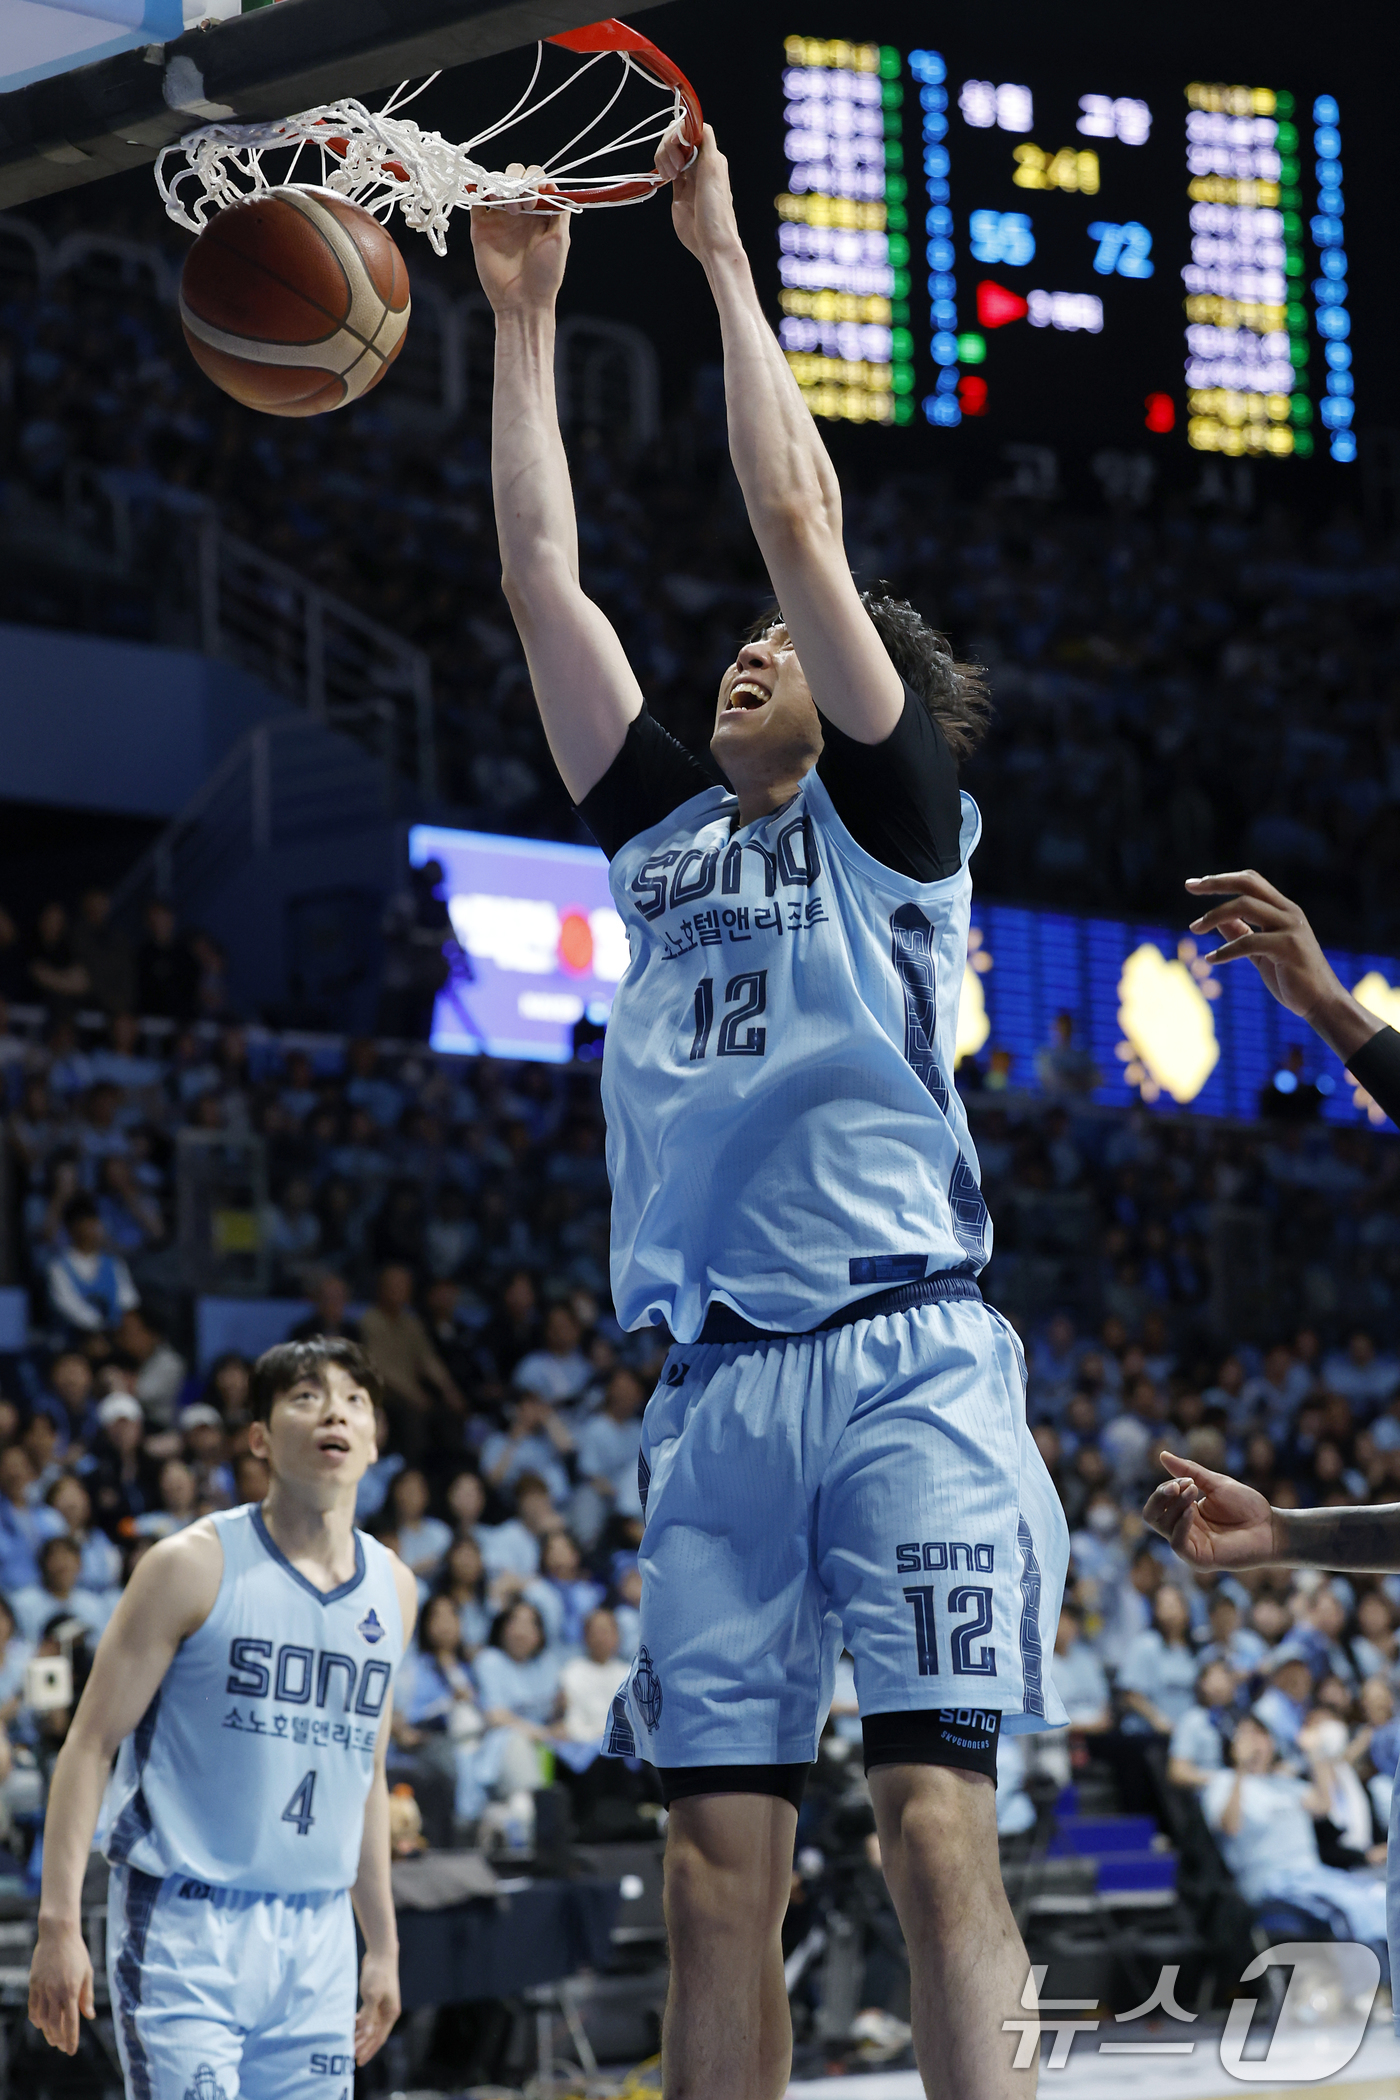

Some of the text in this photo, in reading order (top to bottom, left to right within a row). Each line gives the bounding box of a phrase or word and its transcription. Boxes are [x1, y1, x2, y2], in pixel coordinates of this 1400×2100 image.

[1087, 221, 1154, 279] 72
[689, 969, 768, 1060] 12
[903, 1585, 997, 1677] 12
[941, 1730, 990, 1750] SKYGUNNERS
[281, 1770, 317, 1836] 4
